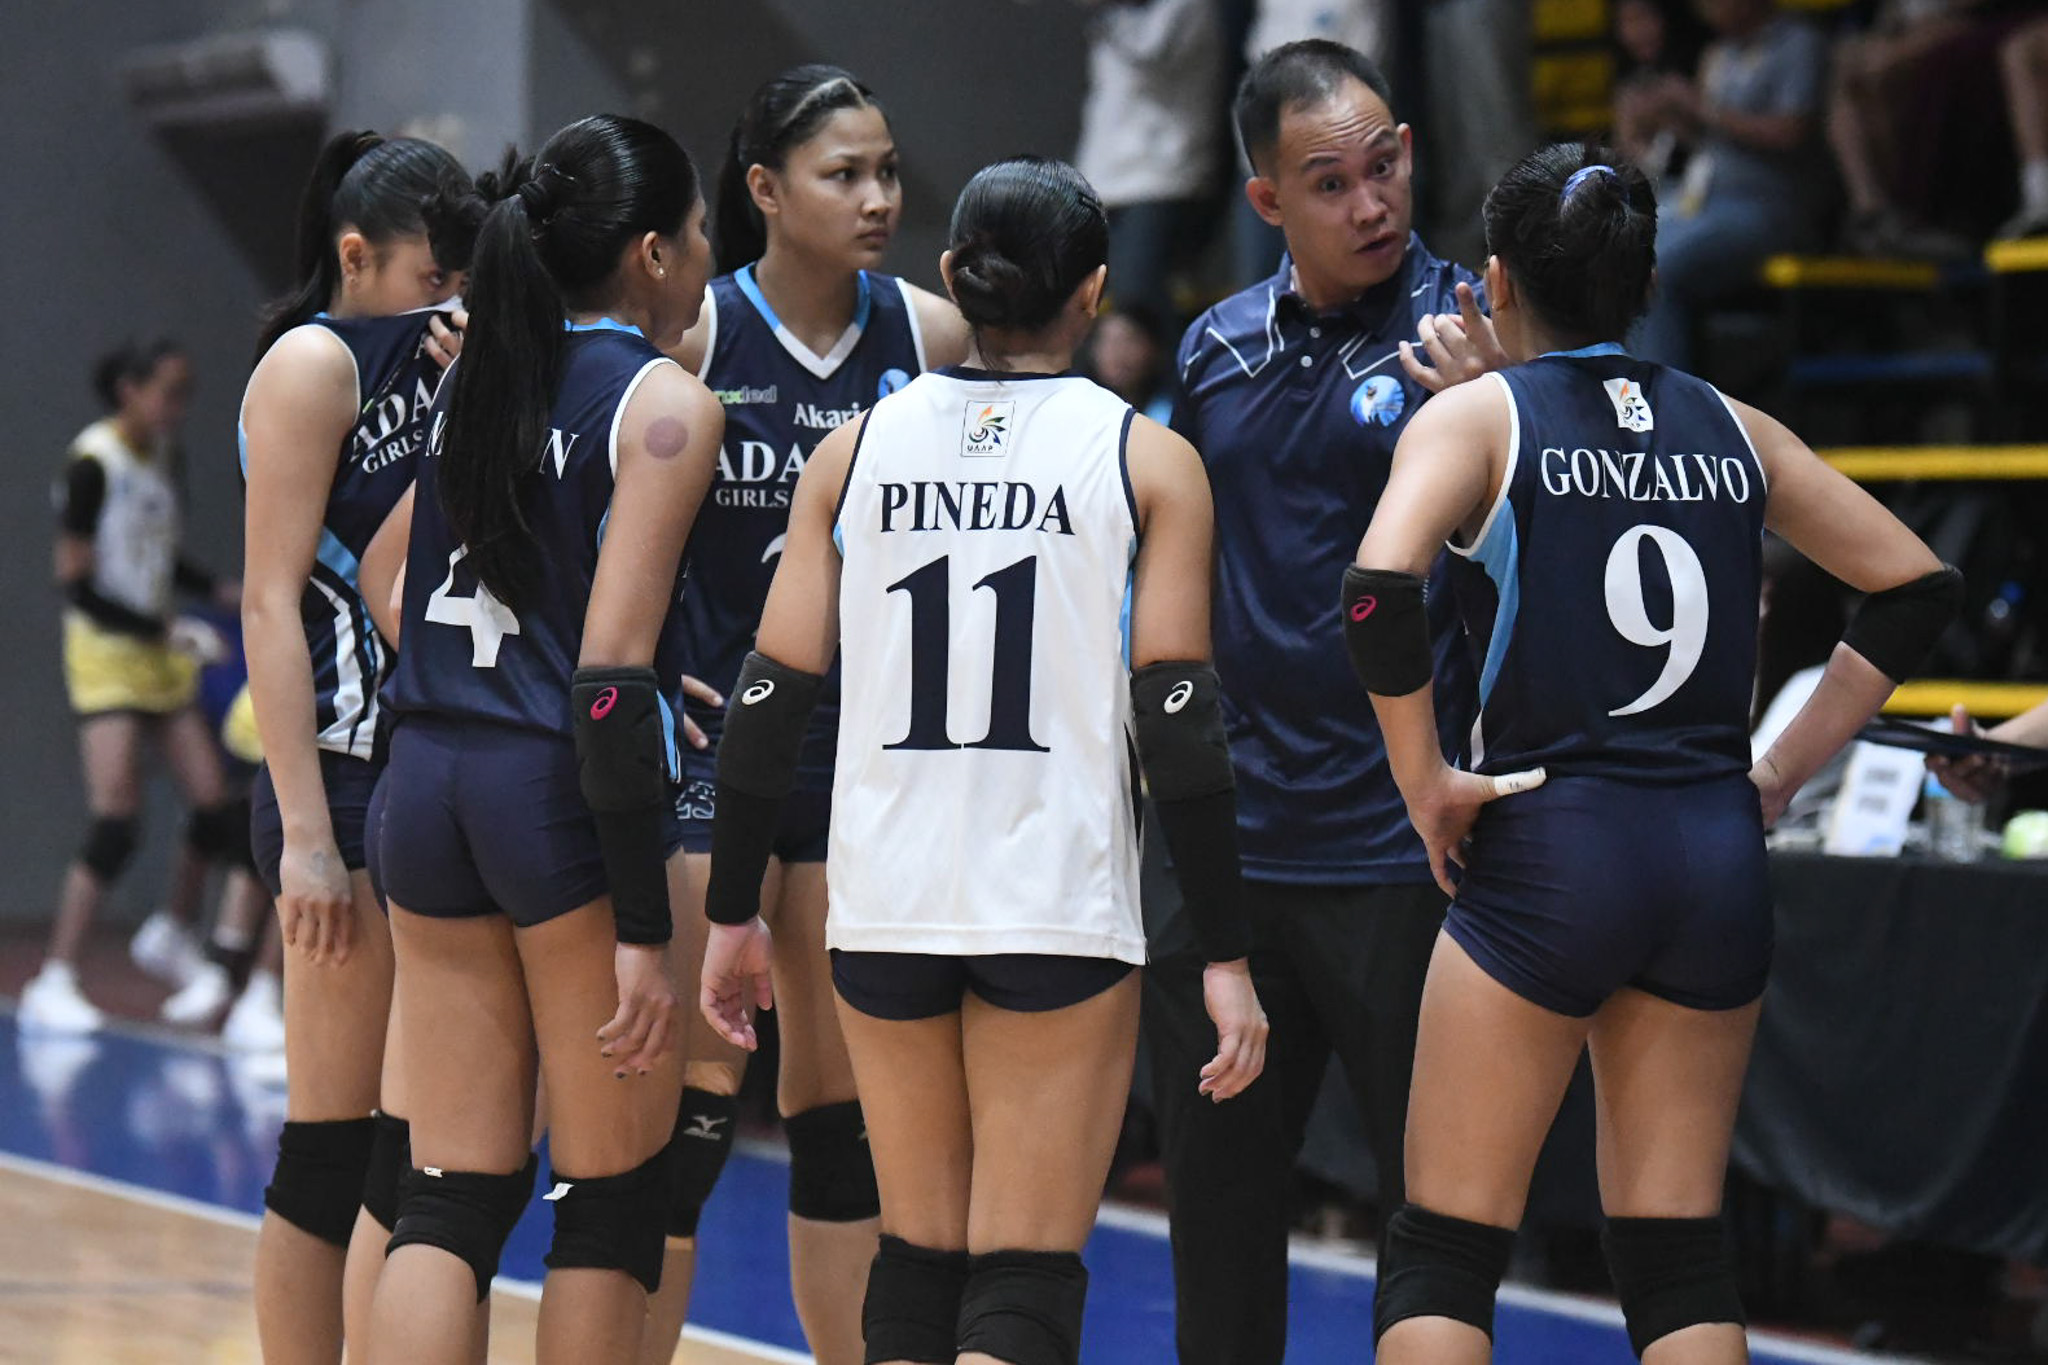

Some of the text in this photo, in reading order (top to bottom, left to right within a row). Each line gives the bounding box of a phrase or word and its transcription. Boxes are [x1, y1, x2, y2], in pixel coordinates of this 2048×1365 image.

[794, 402, 861, 429] Akari
[362, 429, 423, 474] GIRLS
[715, 441, 808, 483] ADA
[1541, 448, 1749, 503] GONZALVO
[715, 488, 789, 508] GIRLS
[878, 481, 1076, 536] PINEDA
[424, 542, 520, 668] 4
[1604, 524, 1709, 716] 9
[882, 554, 1051, 753] 11
